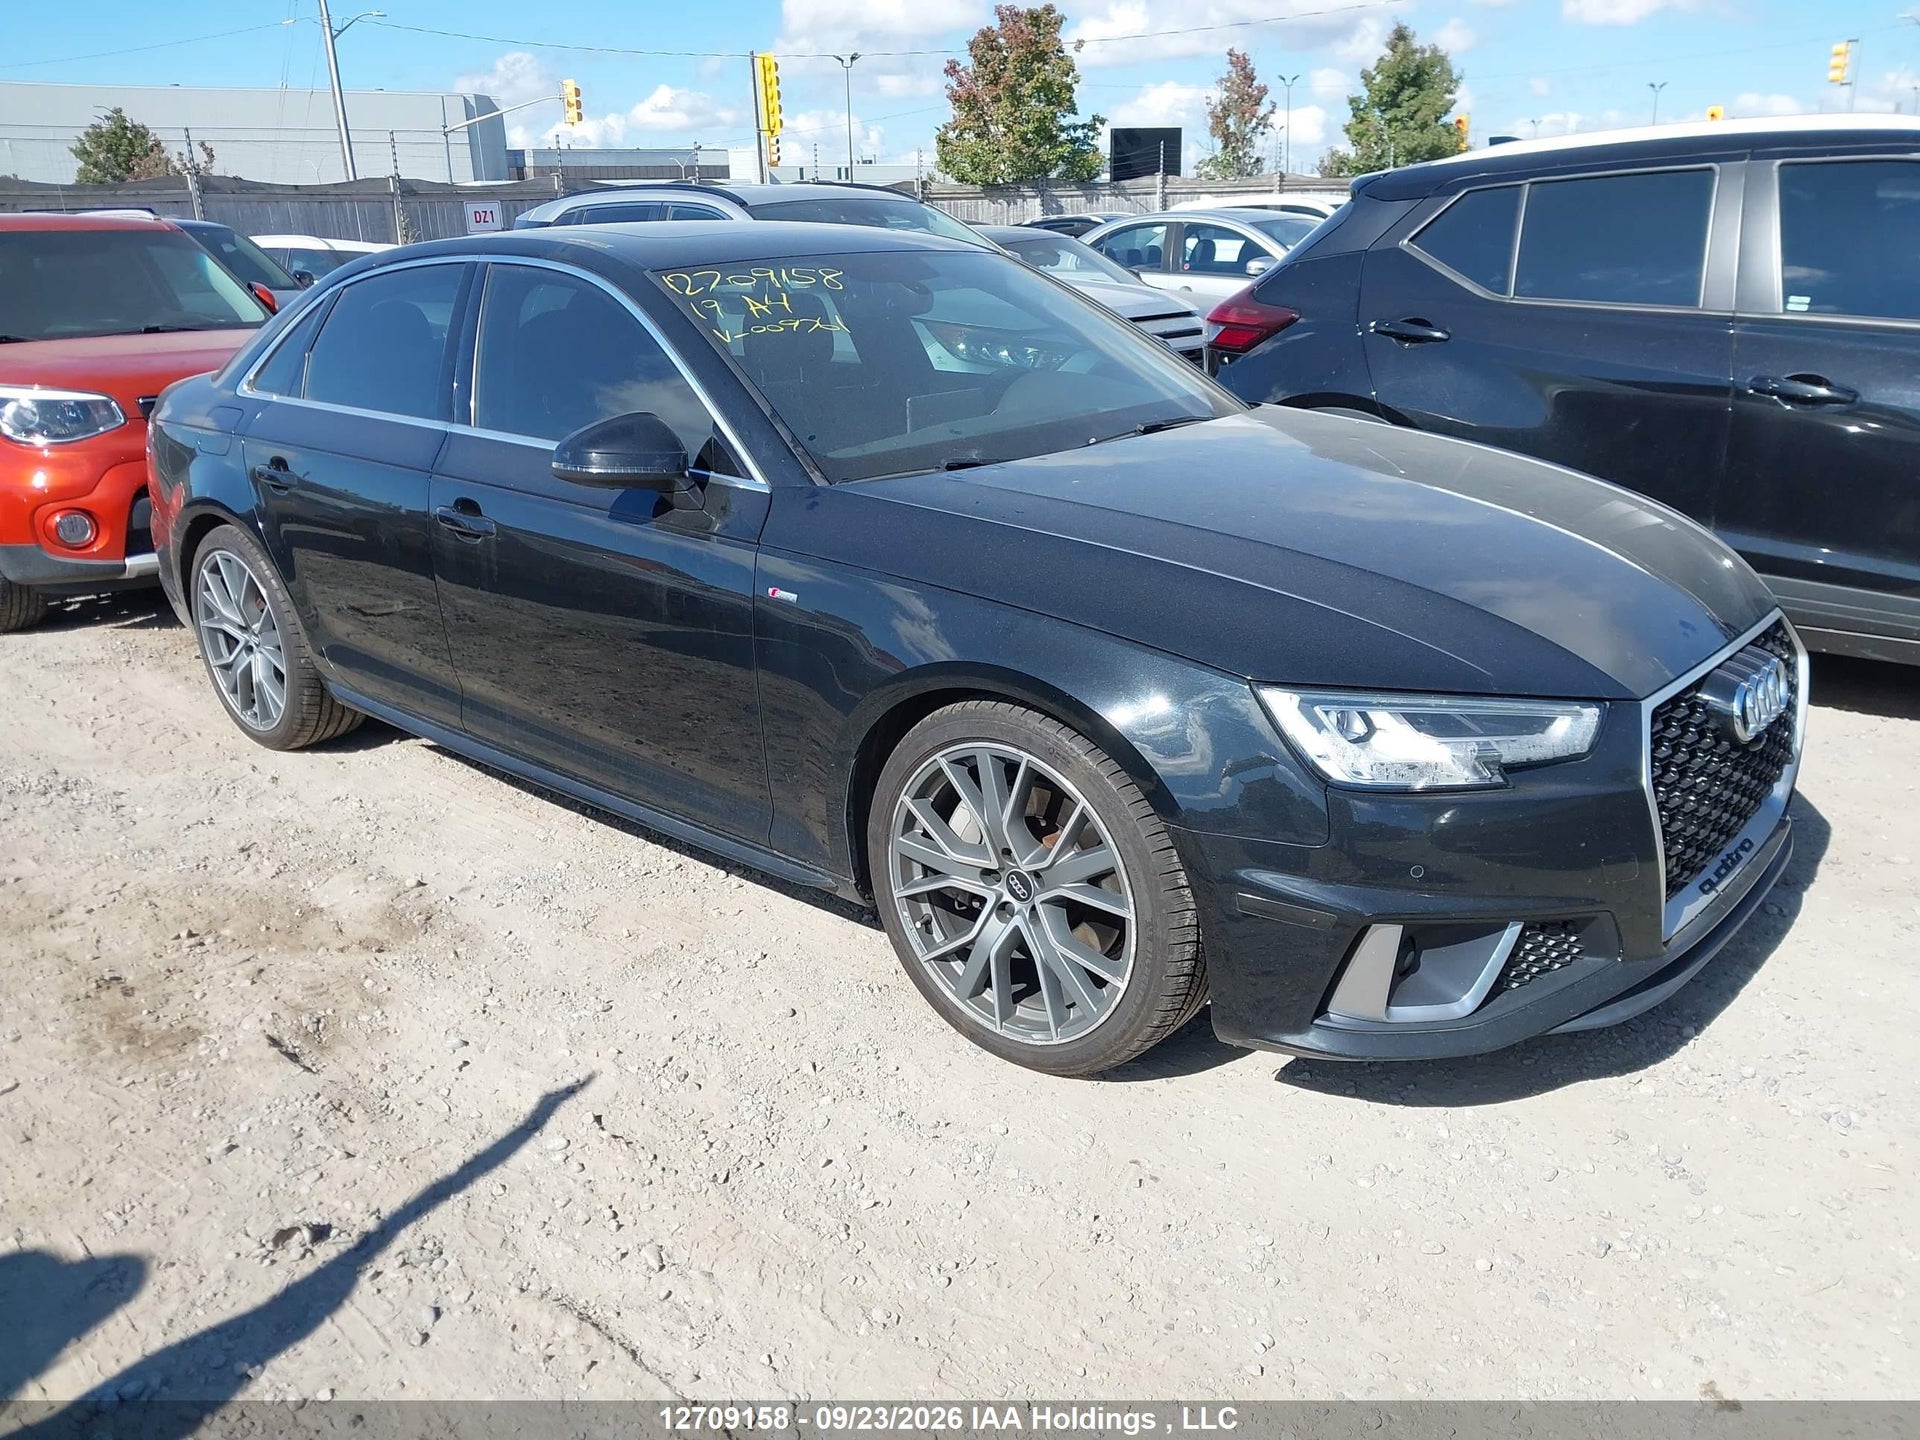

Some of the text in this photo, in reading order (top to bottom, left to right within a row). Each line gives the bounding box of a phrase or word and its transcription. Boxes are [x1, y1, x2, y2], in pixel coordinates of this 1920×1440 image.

[473, 210, 495, 224] DZ1
[662, 268, 843, 294] 12709158
[690, 291, 793, 319] 19 A4
[1698, 838, 1755, 896] quattro
